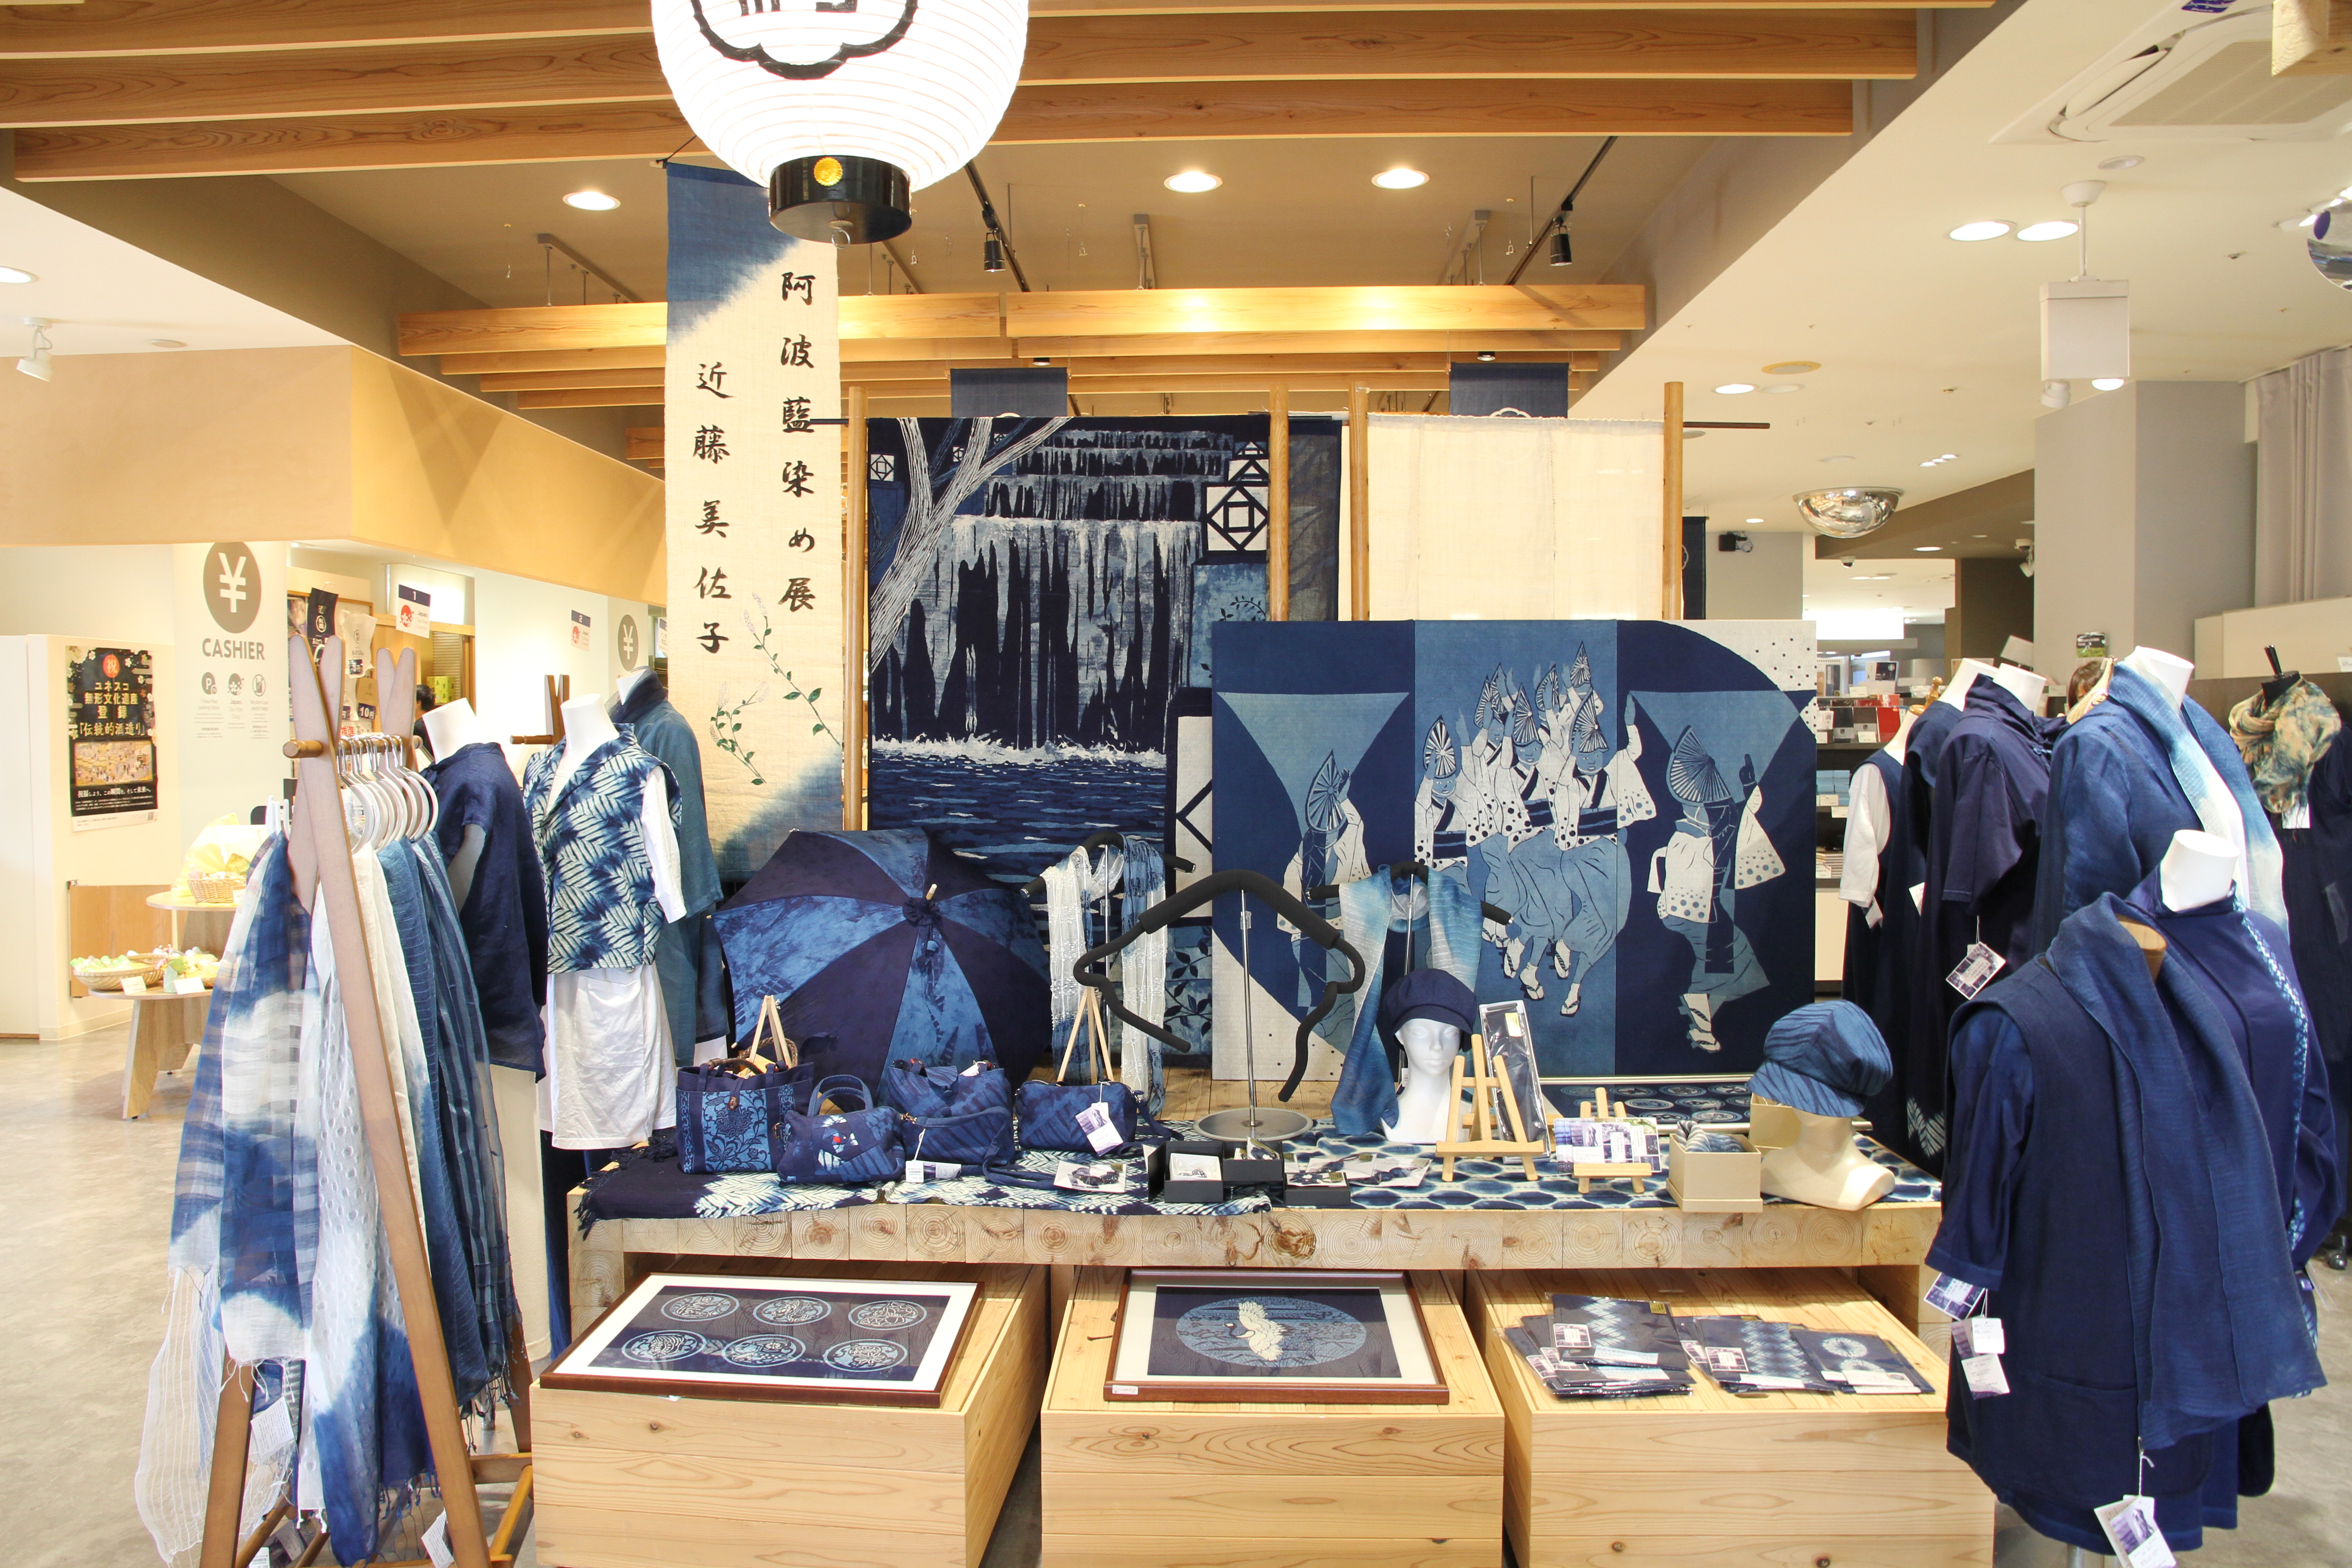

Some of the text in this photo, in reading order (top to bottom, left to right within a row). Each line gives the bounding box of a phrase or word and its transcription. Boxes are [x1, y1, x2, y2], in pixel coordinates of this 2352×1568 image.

[778, 272, 816, 612] 阿波藍染め展
[693, 362, 735, 654] 近藤美佐子
[202, 638, 265, 660] CASHIER
[107, 659, 118, 674] 祝
[94, 681, 129, 691] ユネスコ
[84, 692, 138, 705] 無形文化遺産
[98, 705, 127, 719] 登録
